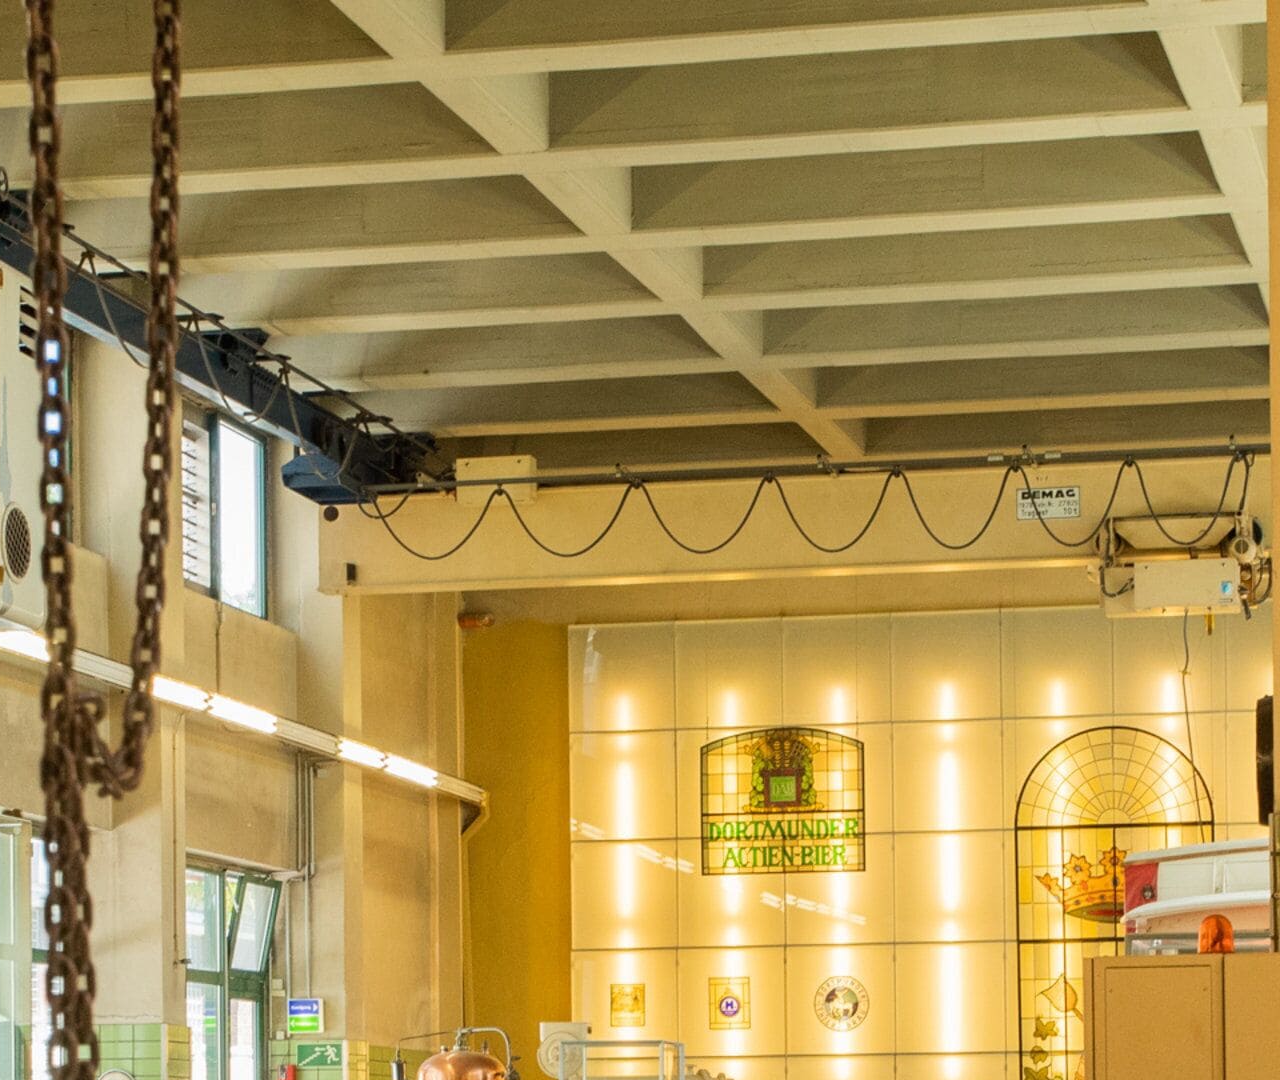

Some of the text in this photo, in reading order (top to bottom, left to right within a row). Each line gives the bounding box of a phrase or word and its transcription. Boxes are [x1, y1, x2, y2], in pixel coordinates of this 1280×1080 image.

[1021, 489, 1076, 500] DEMAG
[708, 818, 859, 842] DORTMUNDER
[722, 844, 848, 868] ACTIEN-BIER
[725, 1000, 735, 1010] H
